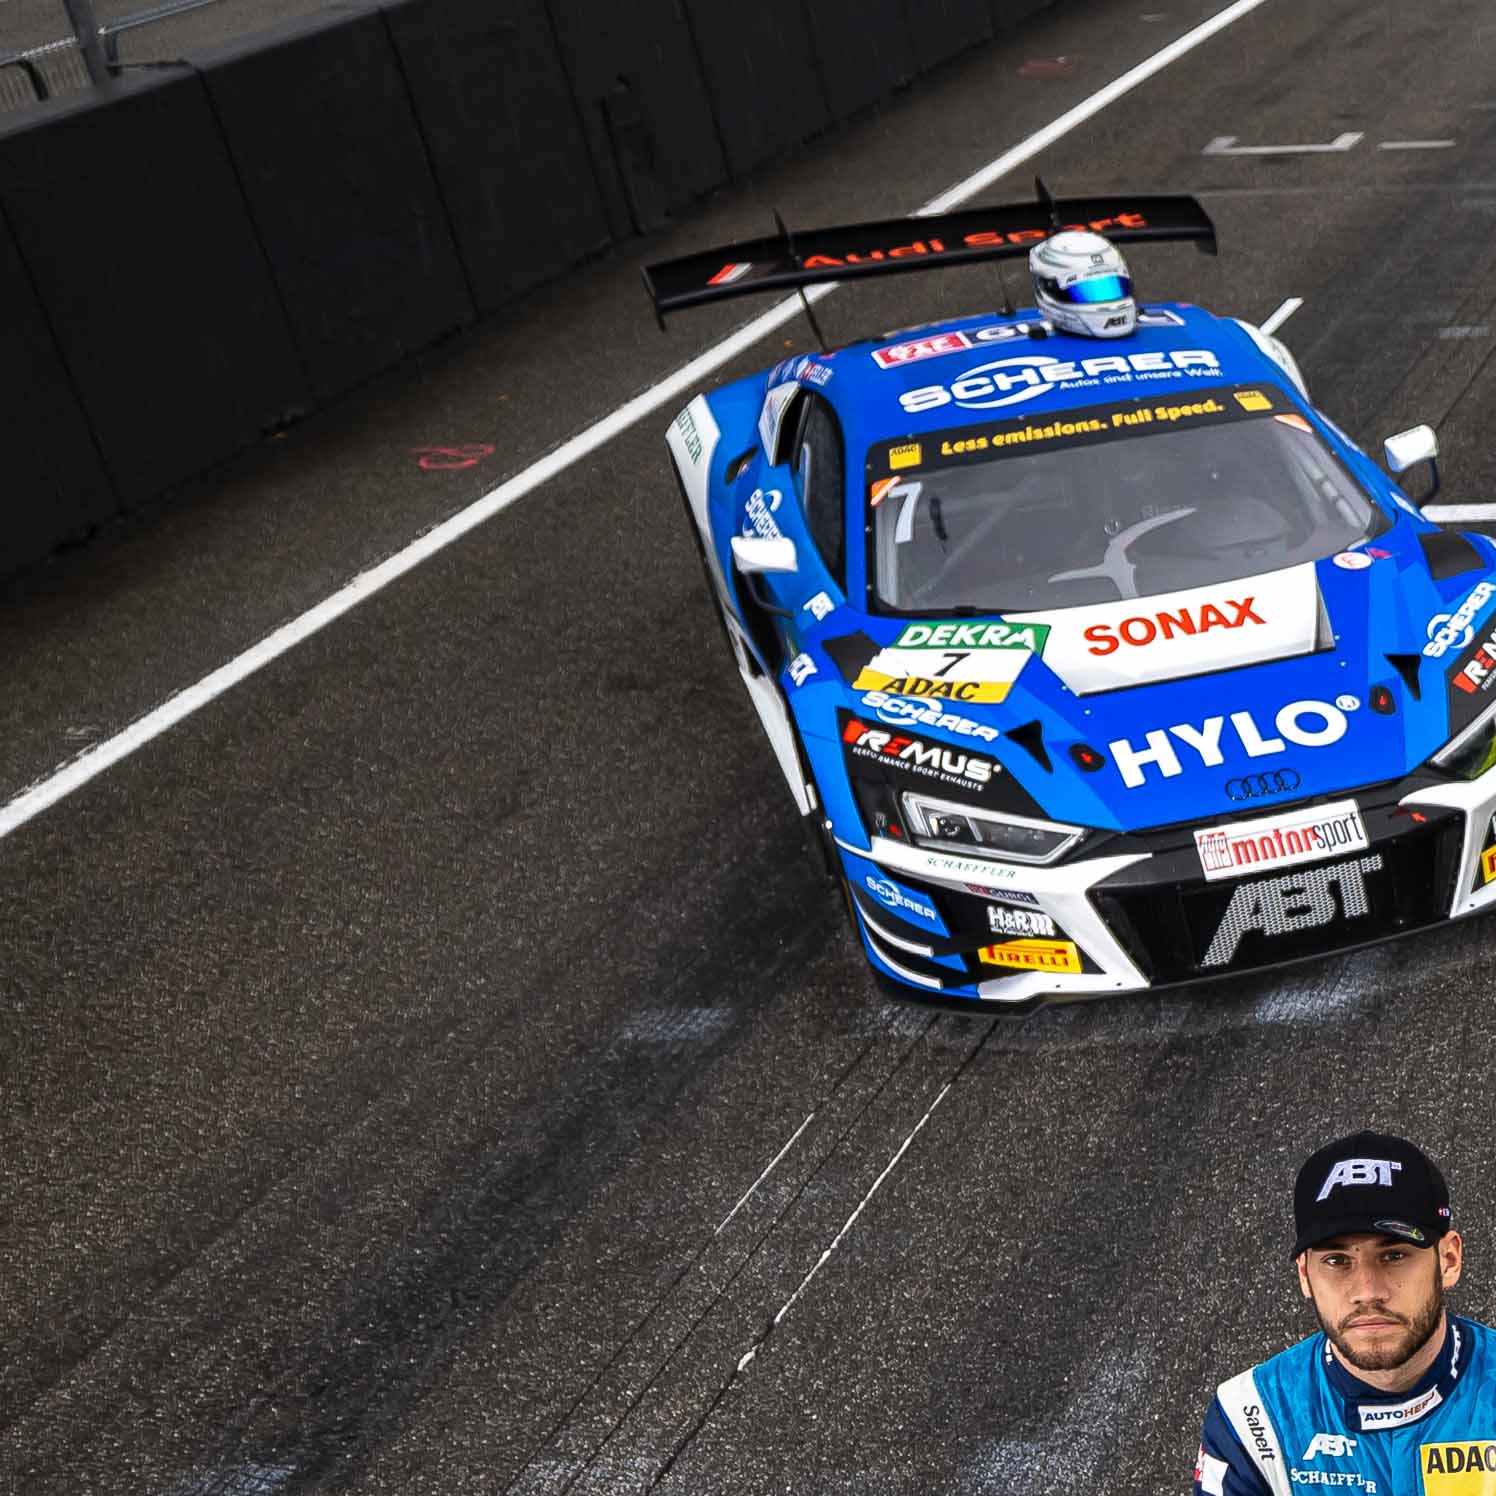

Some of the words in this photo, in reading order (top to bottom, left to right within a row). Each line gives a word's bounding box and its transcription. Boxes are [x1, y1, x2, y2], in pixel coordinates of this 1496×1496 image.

[802, 238, 945, 269] Audi
[898, 350, 1221, 413] SCHERER
[941, 437, 989, 456] Less
[991, 417, 1109, 448] emissions.
[1111, 408, 1153, 428] Full
[1154, 399, 1226, 423] Speed.
[887, 481, 924, 545] 7
[896, 623, 1038, 651] DEKRA
[1085, 597, 1266, 657] SONAX
[883, 675, 981, 701] ADAC
[932, 651, 971, 678] 7
[860, 690, 1001, 743] SCHERER
[856, 728, 995, 783] REMUS
[1107, 699, 1350, 790] HYLO
[1231, 812, 1363, 866] motorsport
[926, 856, 1017, 880] SCHAEFFLER
[865, 875, 937, 922] SCHERER
[1199, 853, 1384, 968] ABT
[986, 944, 1070, 969] PIRELLI
[1315, 1158, 1403, 1203] ABT
[1242, 1404, 1276, 1462] Sabelt
[1302, 1432, 1358, 1461] ABT
[1290, 1467, 1378, 1494] SCHAEFFLR
